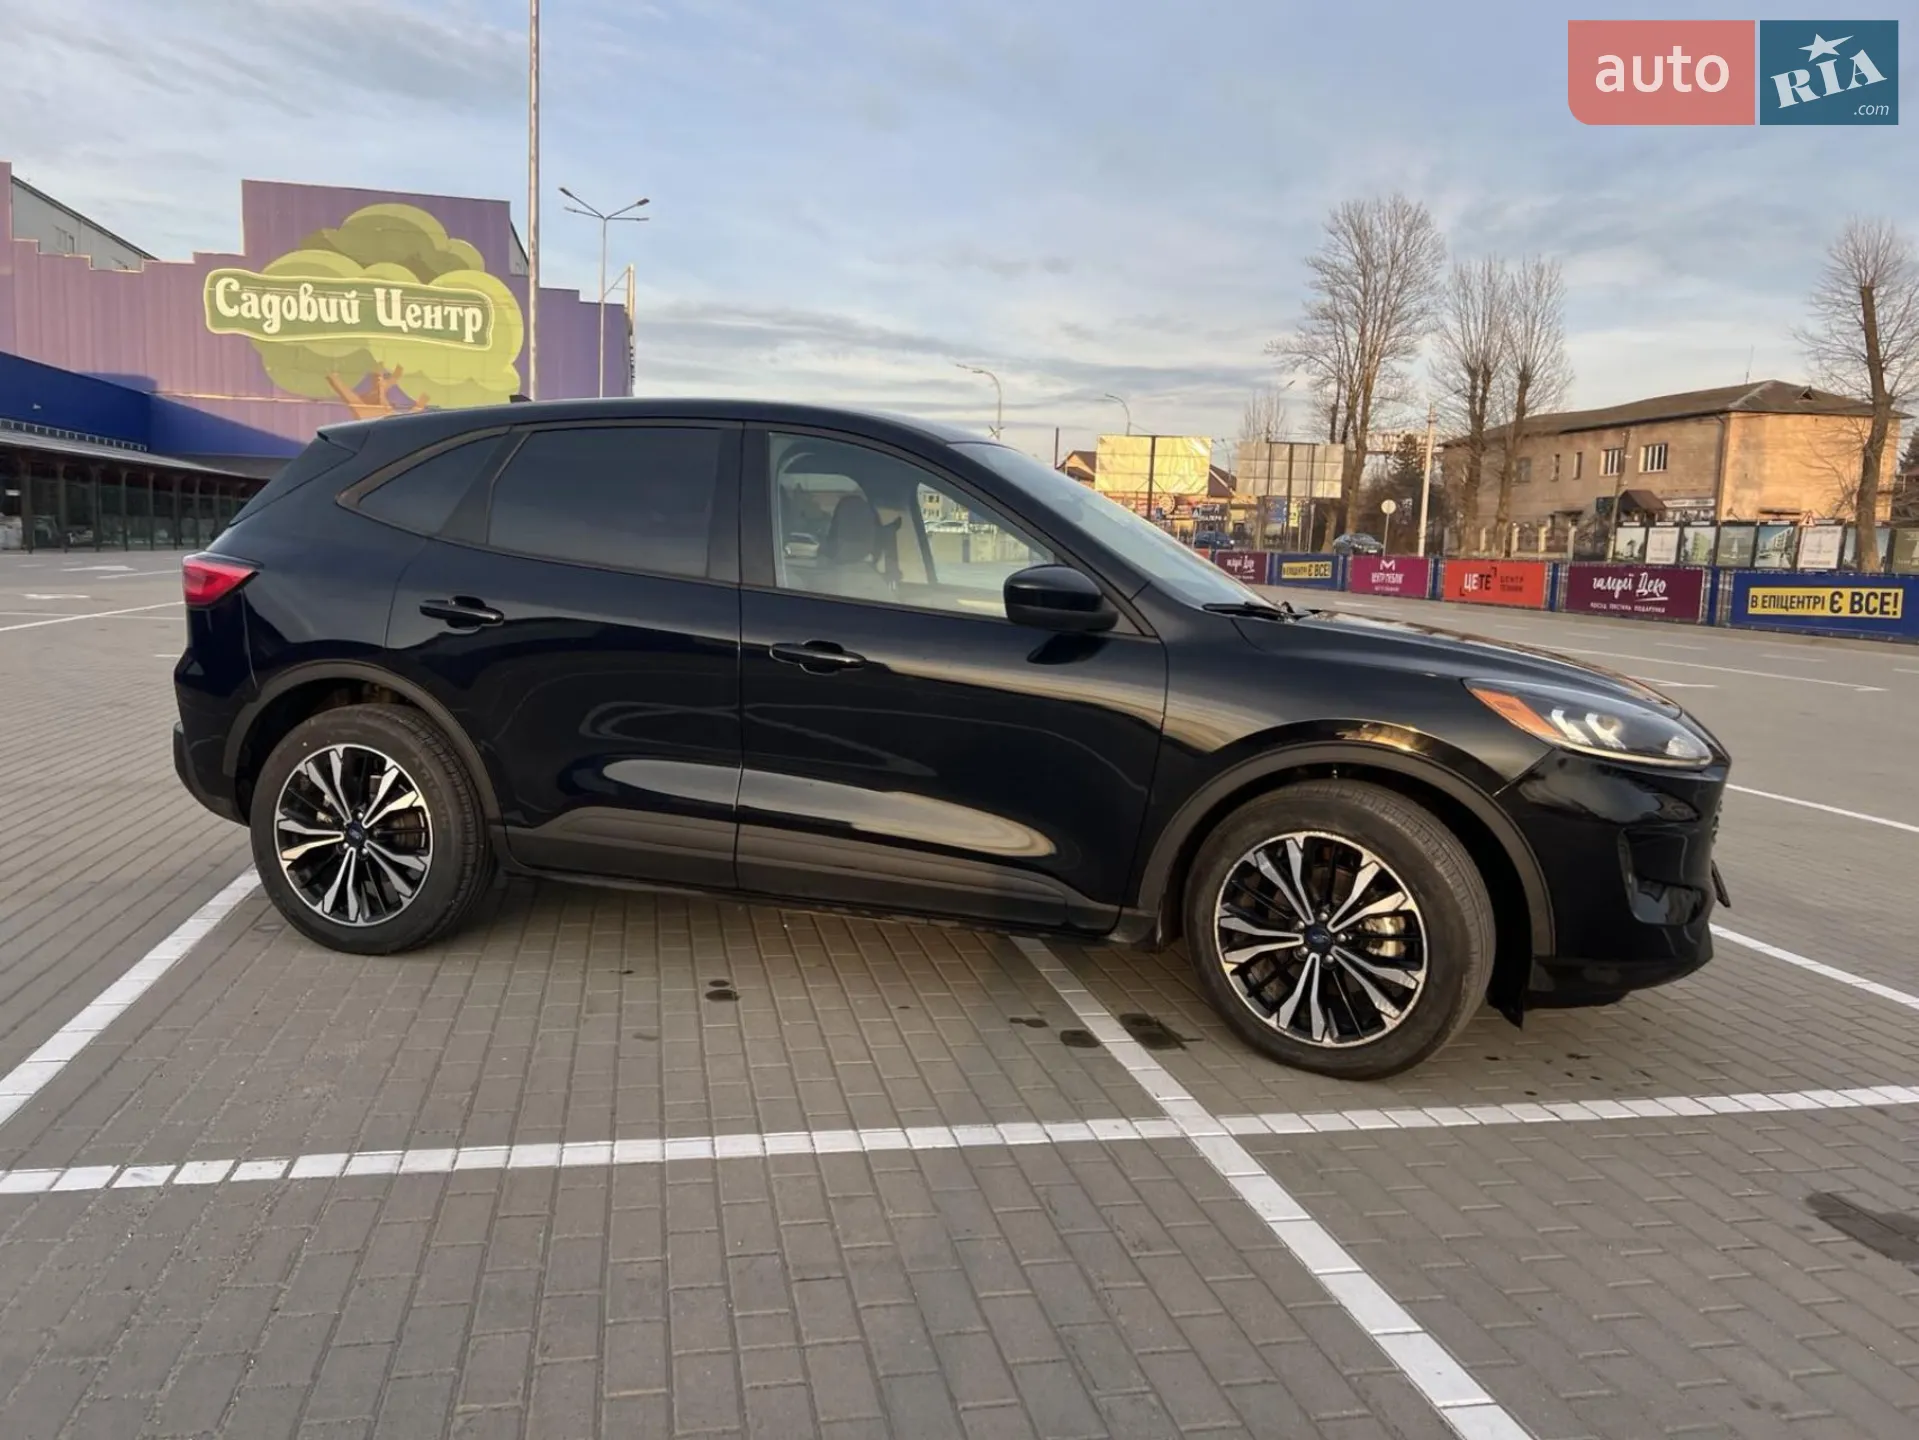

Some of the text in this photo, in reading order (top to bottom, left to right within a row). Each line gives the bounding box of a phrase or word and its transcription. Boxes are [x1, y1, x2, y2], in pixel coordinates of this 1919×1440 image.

[215, 277, 484, 343] Садовий Центр
[1750, 590, 1899, 616] В ЕПІЦЕНТРІ Є ВСЕ!
